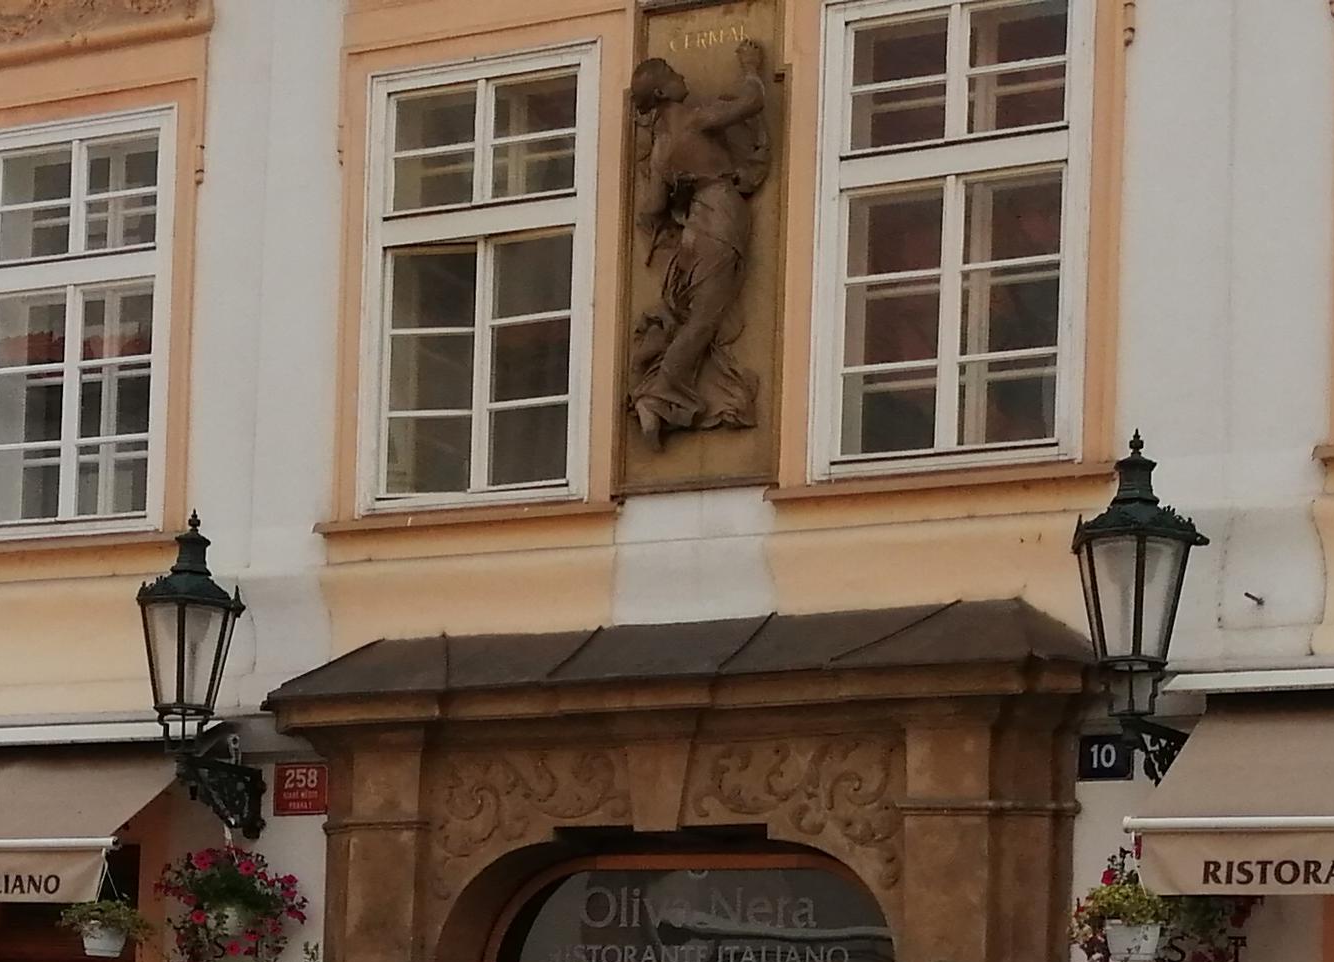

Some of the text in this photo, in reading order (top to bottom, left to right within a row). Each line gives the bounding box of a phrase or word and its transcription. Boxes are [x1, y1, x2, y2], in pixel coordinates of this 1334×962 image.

[1090, 743, 1116, 769] 10
[284, 768, 318, 789] 258
[579, 885, 817, 929] Oliva Nera
